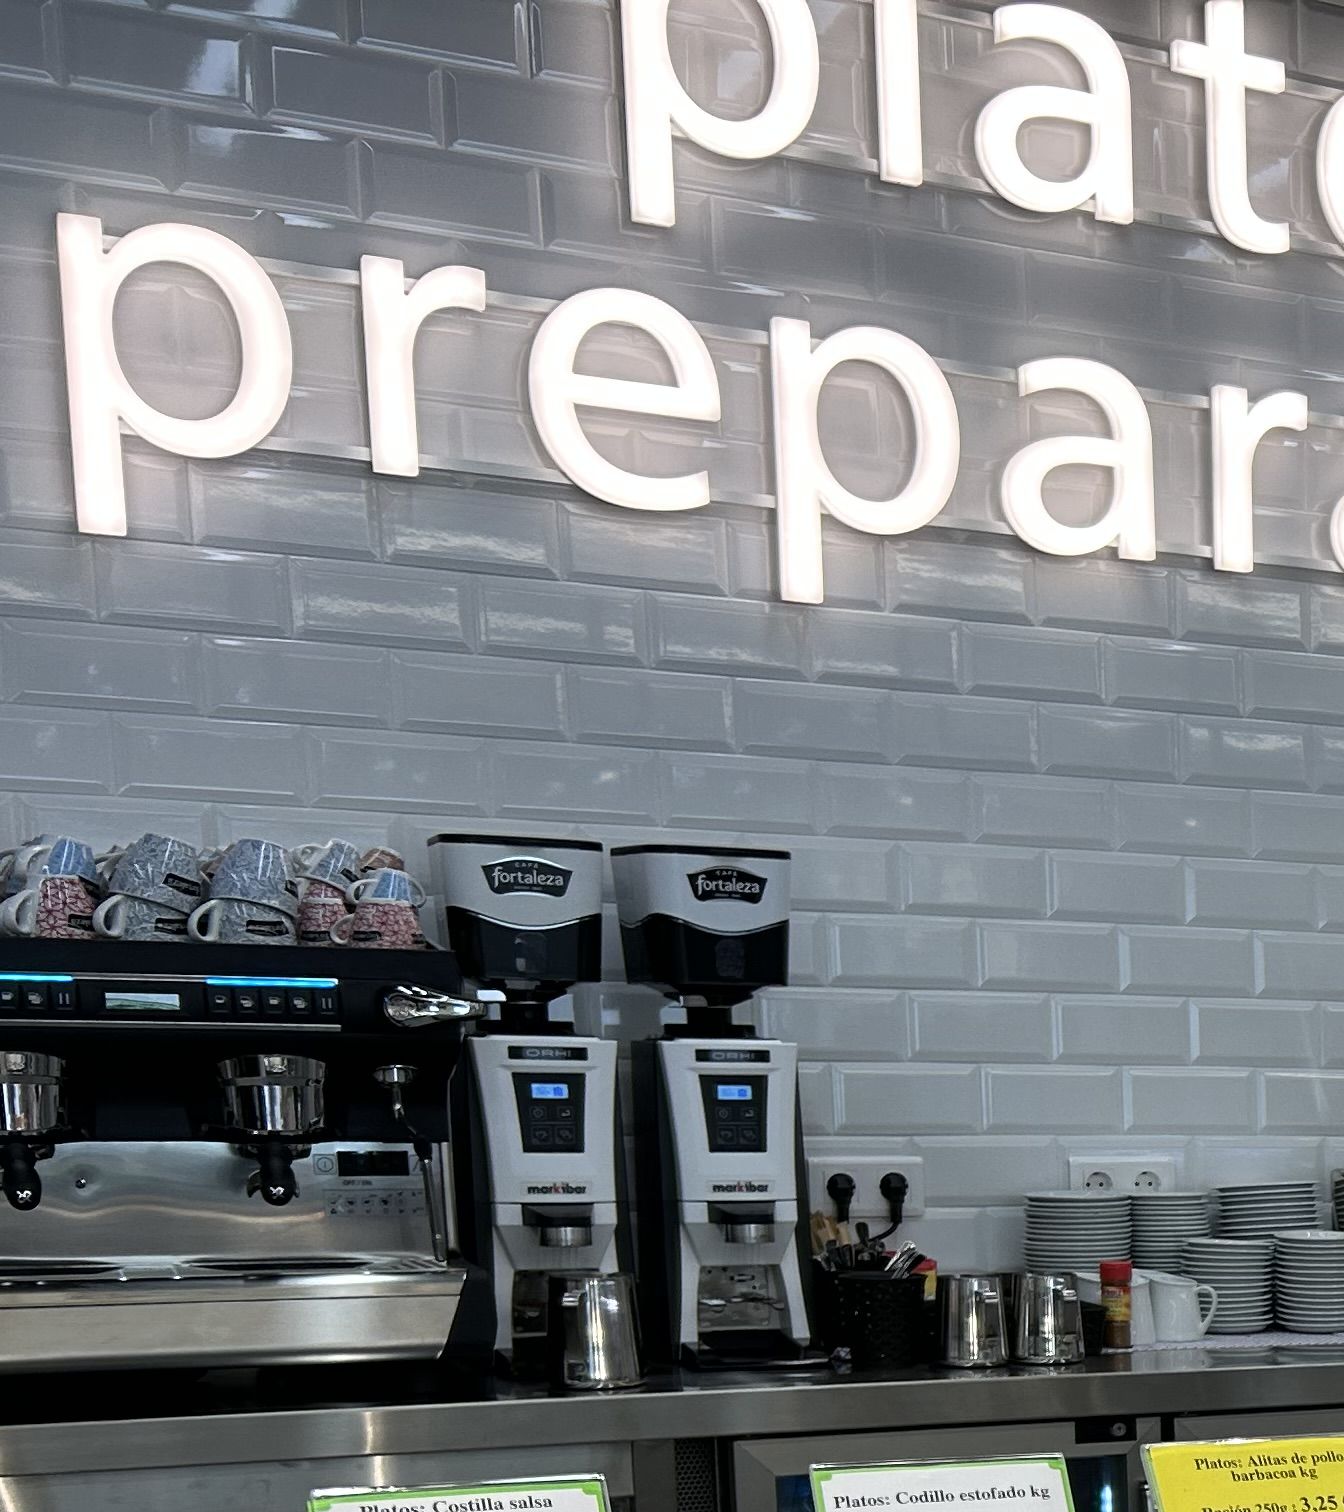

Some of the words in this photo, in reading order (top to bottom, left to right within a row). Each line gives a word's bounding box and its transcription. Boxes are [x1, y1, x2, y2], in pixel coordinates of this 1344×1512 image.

[492, 867, 564, 888] fortaleza
[696, 874, 760, 895] fortaleza
[527, 1185, 587, 1195] markibar
[713, 1183, 768, 1193] markibar
[1194, 1457, 1243, 1471] Platos:
[1248, 1455, 1288, 1467] Alitas
[1291, 1452, 1308, 1465] de
[1311, 1451, 1344, 1466] pollo
[1232, 1468, 1296, 1482] barbacoa
[1300, 1465, 1319, 1480] kg
[510, 1496, 553, 1510] salsa
[834, 1495, 890, 1508] Platos:
[896, 1488, 955, 1505] Codillo
[960, 1486, 1026, 1502] estofado
[1030, 1485, 1051, 1500] kg
